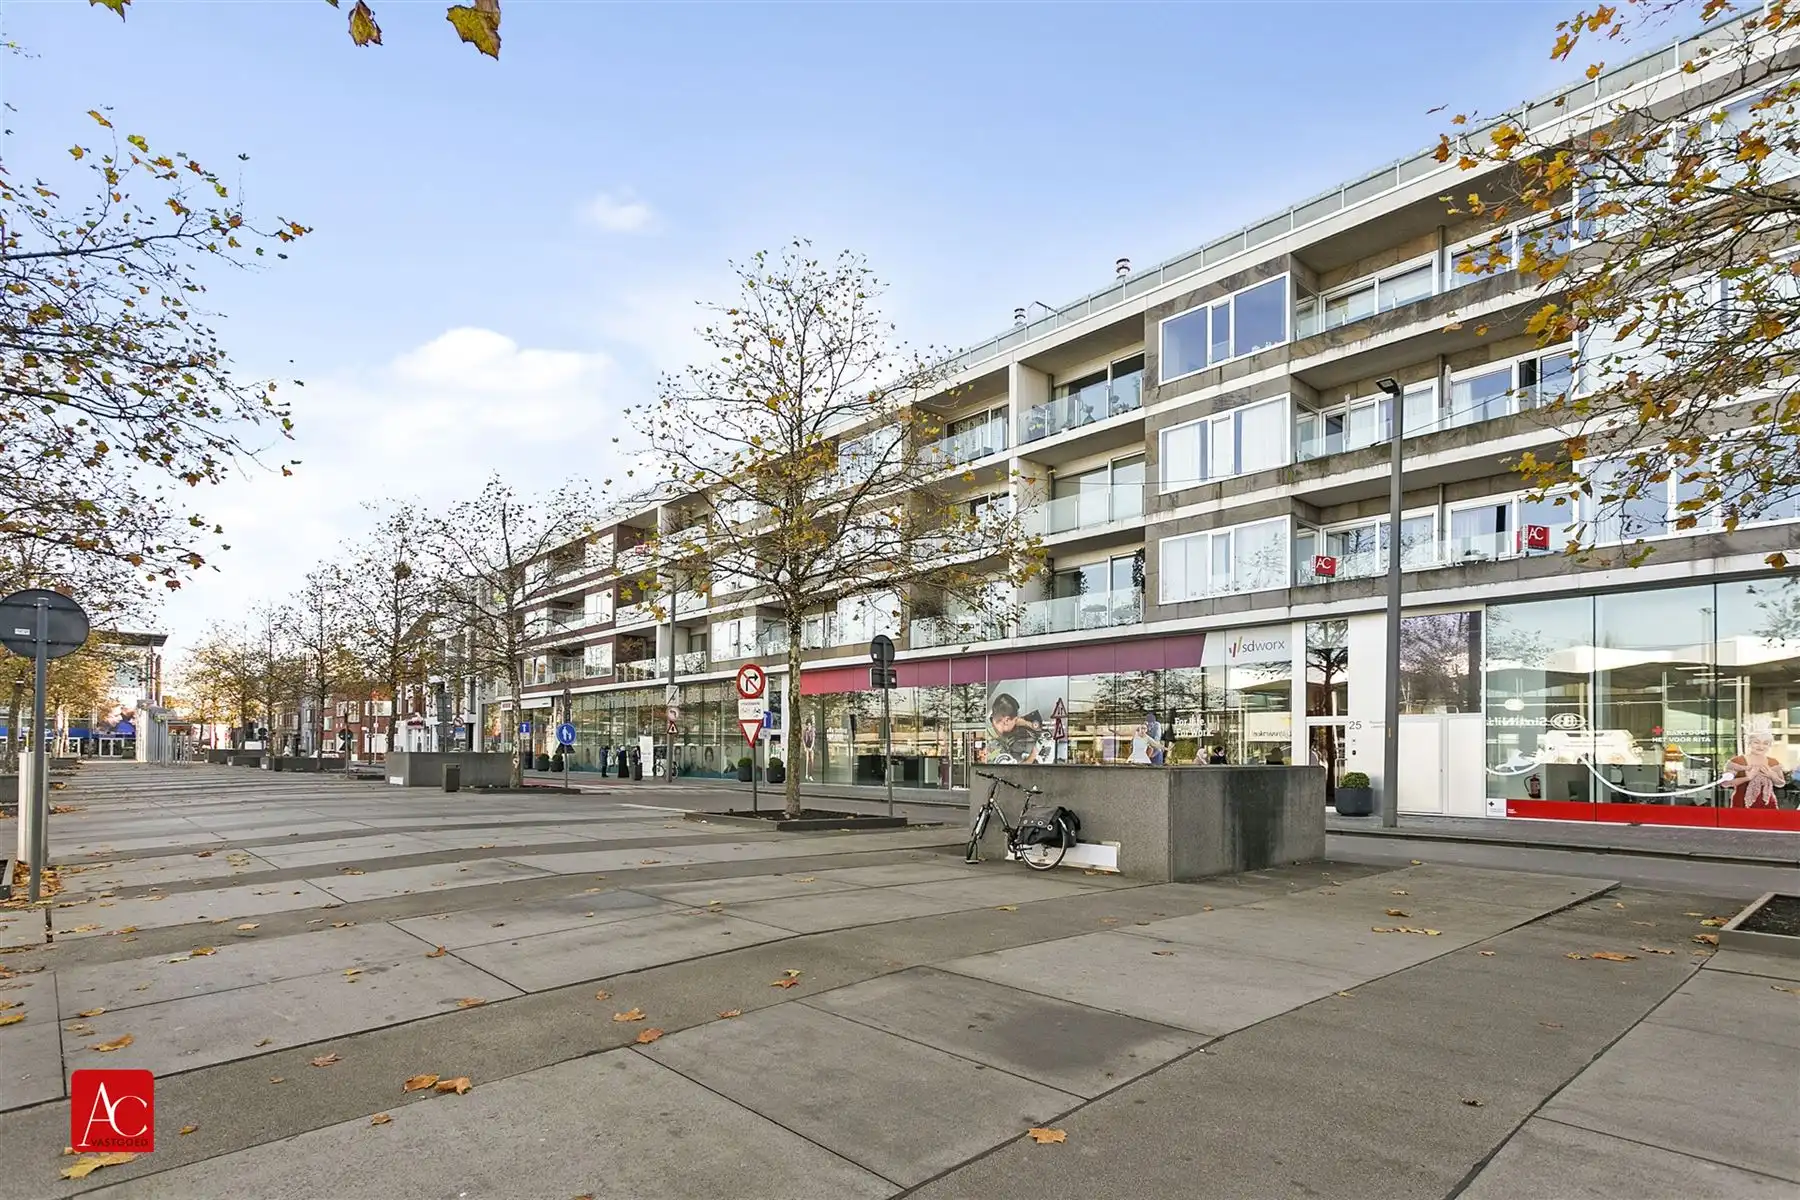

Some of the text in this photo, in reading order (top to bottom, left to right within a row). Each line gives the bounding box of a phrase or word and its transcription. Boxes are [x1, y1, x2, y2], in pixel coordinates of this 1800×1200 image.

[1528, 527, 1544, 540] AC
[1316, 557, 1332, 569] AC
[1349, 721, 1362, 730] 25
